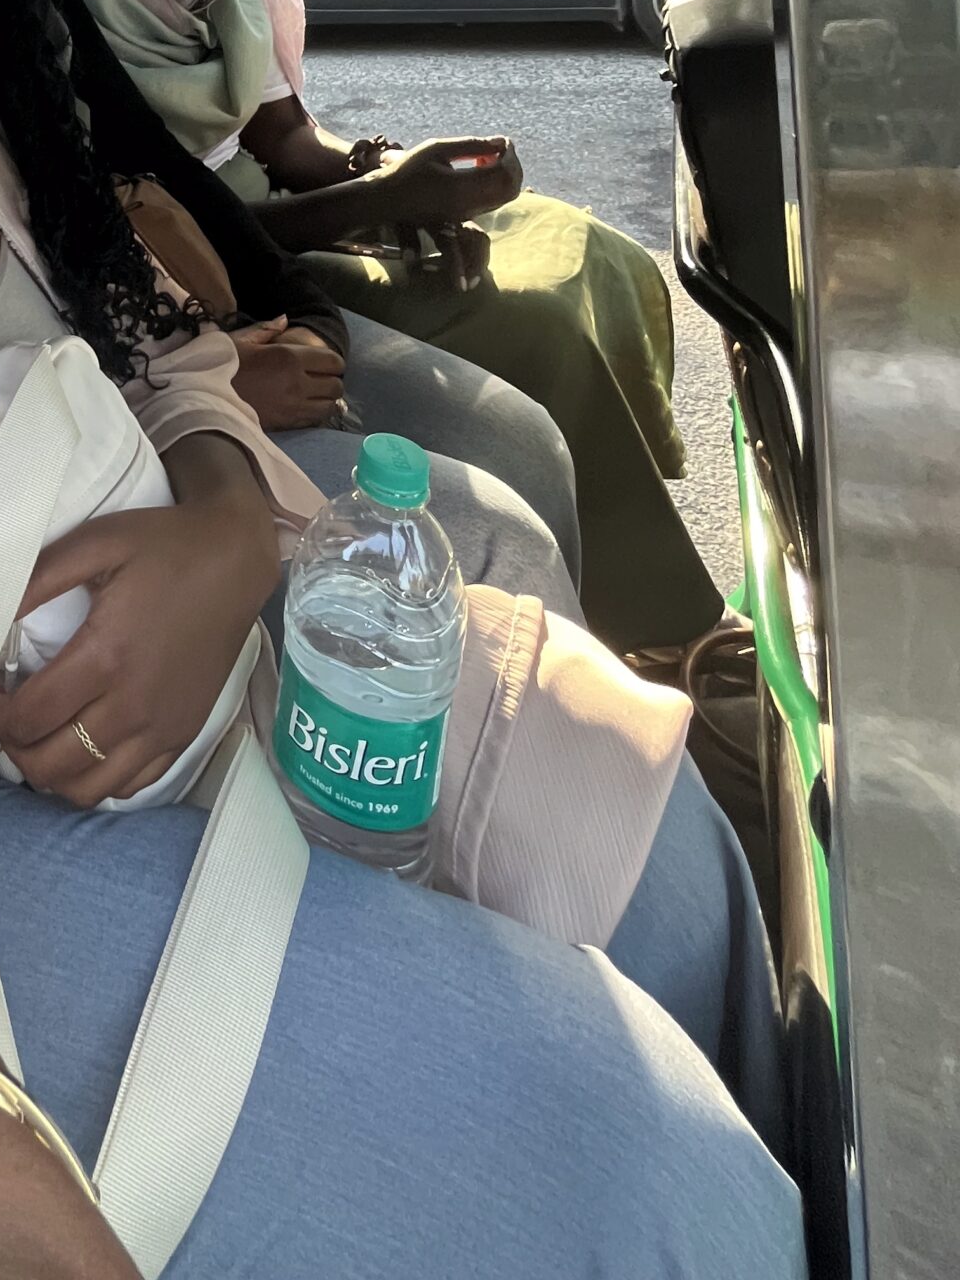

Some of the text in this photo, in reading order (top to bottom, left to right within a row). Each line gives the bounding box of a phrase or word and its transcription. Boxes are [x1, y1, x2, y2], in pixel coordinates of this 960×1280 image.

[288, 702, 429, 786] Bisleri
[300, 764, 400, 814] trusted since 1969
